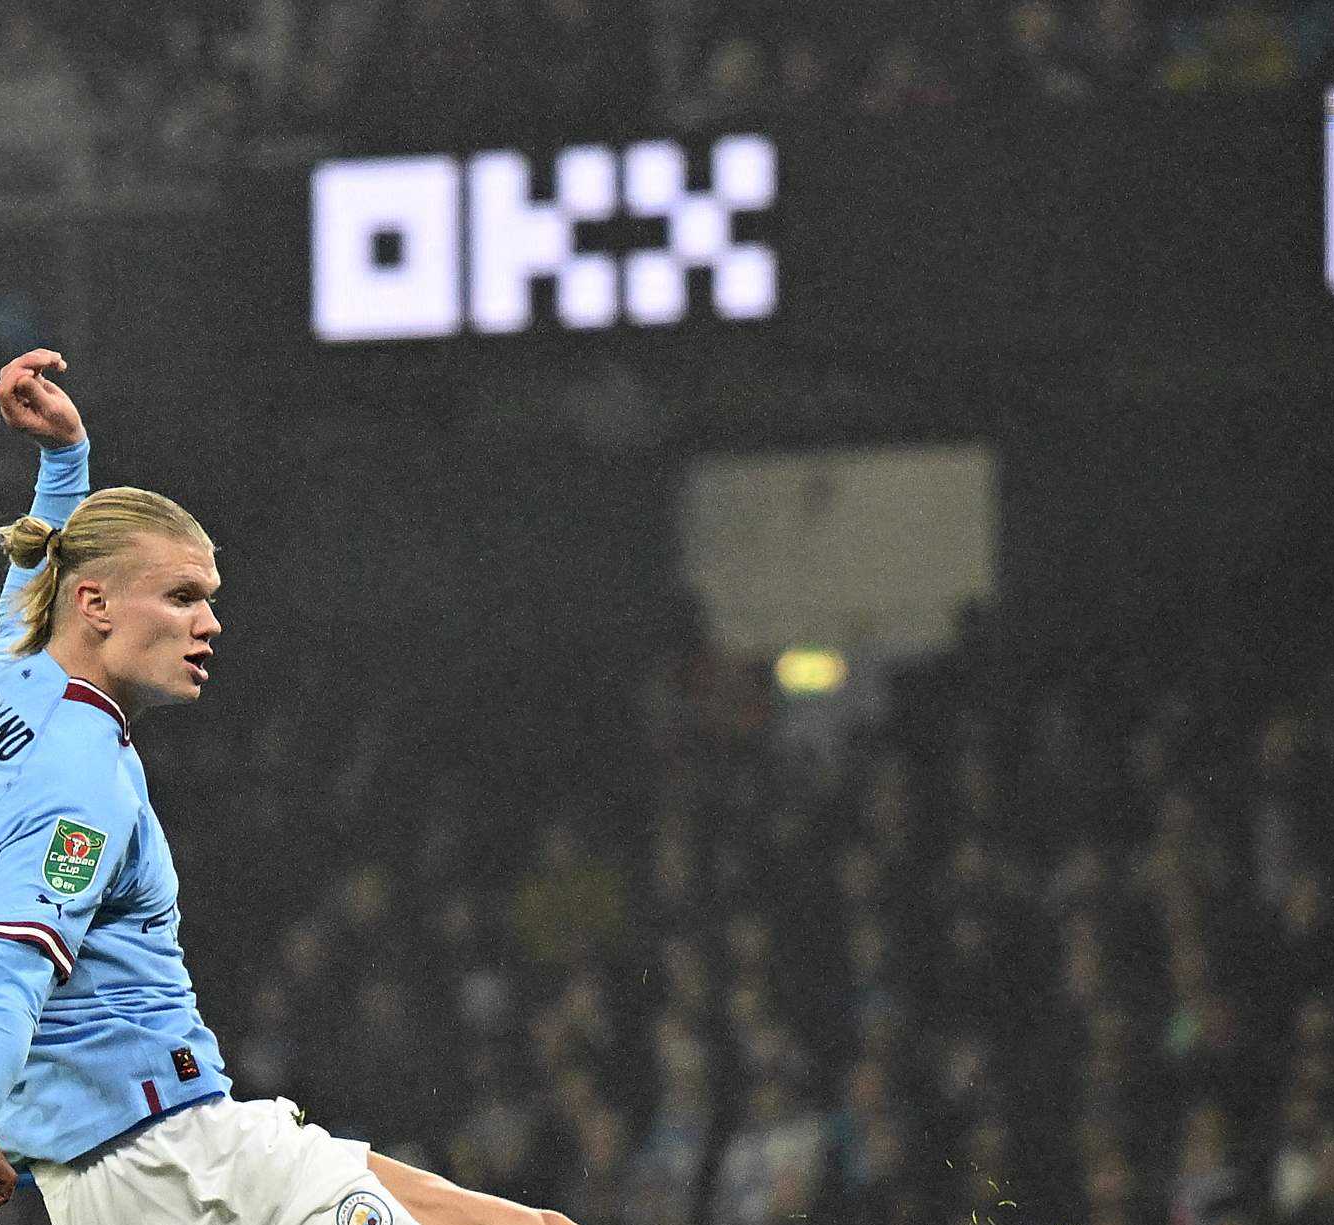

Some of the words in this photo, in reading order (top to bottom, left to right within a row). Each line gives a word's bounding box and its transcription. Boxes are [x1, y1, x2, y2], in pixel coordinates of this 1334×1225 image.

[312, 136, 777, 341] OKX
[49, 851, 96, 867] Carabao
[58, 862, 80, 875] Cup
